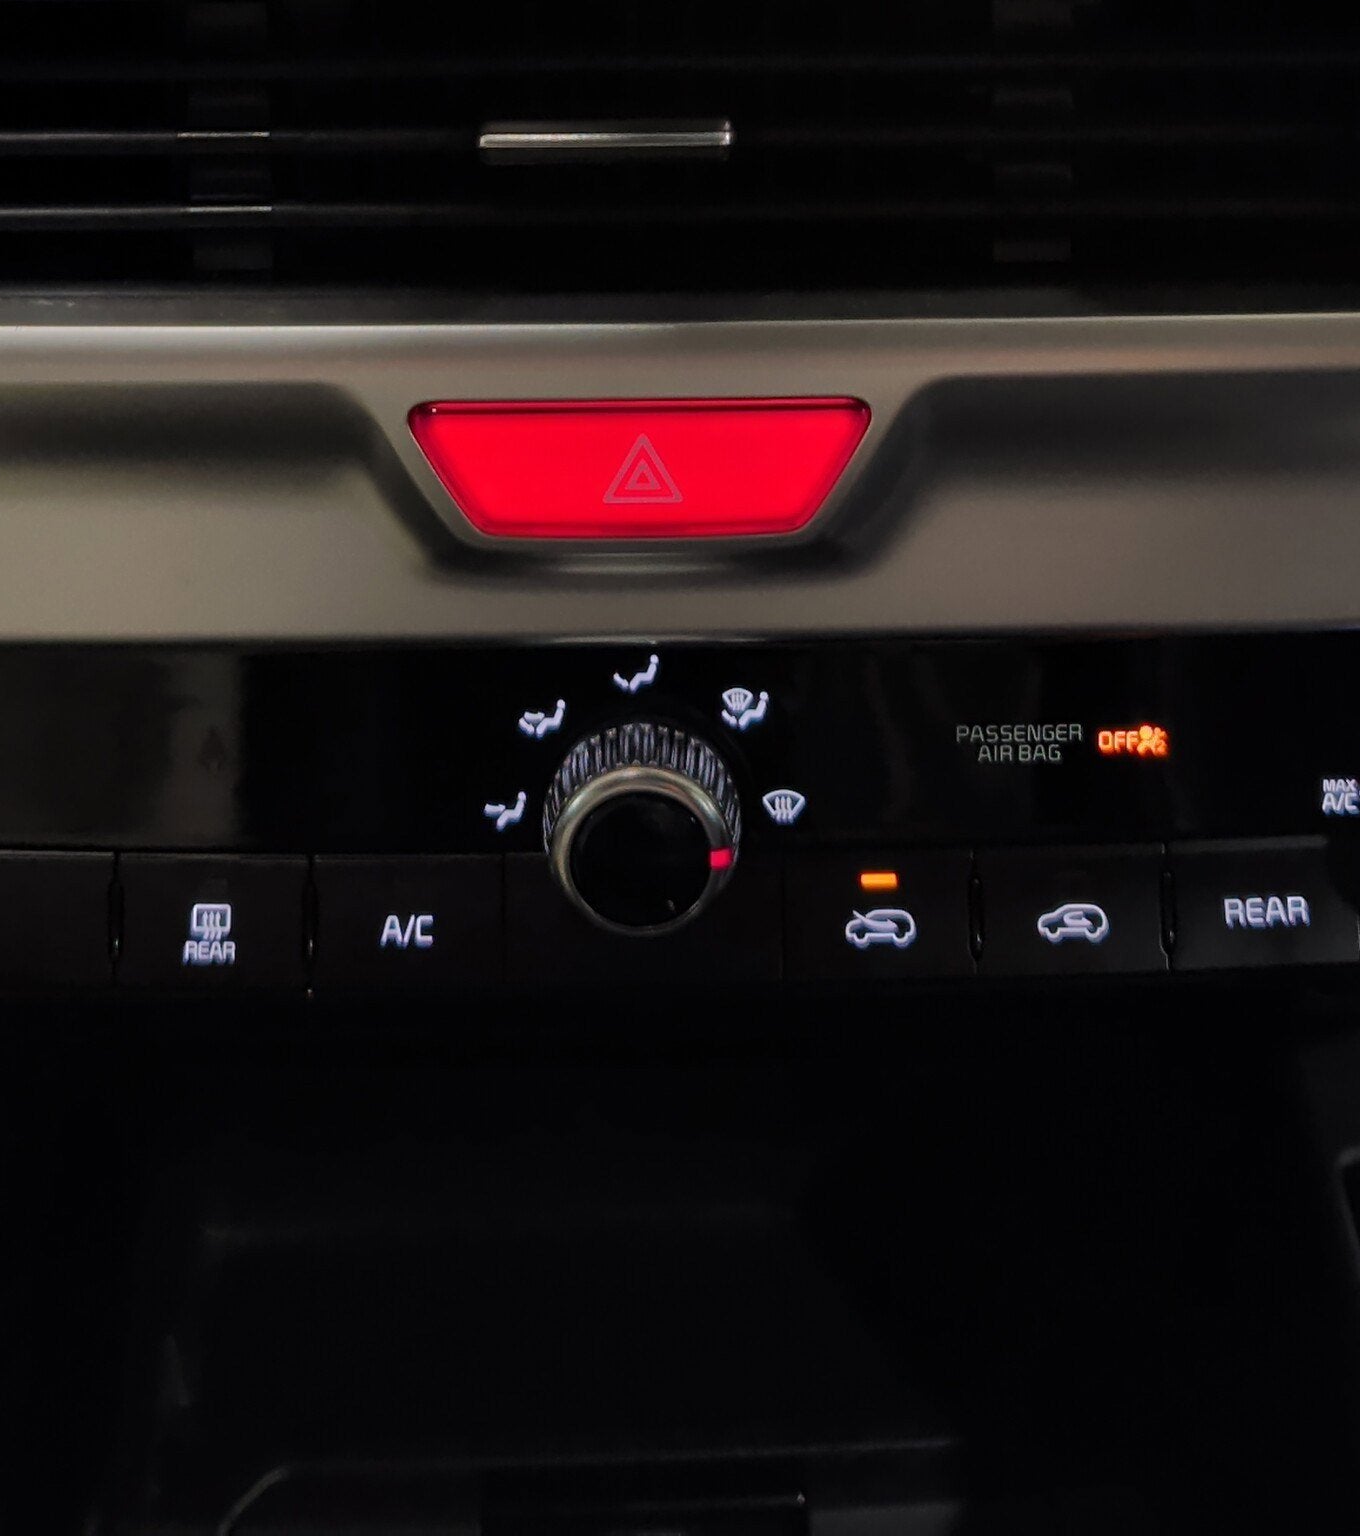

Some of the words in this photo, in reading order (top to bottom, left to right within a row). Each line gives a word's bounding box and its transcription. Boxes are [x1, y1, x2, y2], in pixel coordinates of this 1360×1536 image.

[956, 723, 1083, 743] PASSENGER
[1098, 730, 1138, 753] OFF
[977, 744, 1013, 762] AIR
[1017, 743, 1061, 762] BAG
[1322, 778, 1357, 794] MAX
[1322, 793, 1359, 814] A/C
[1223, 895, 1310, 928] REAR
[380, 914, 434, 947] A/C
[182, 937, 236, 963] REAR
